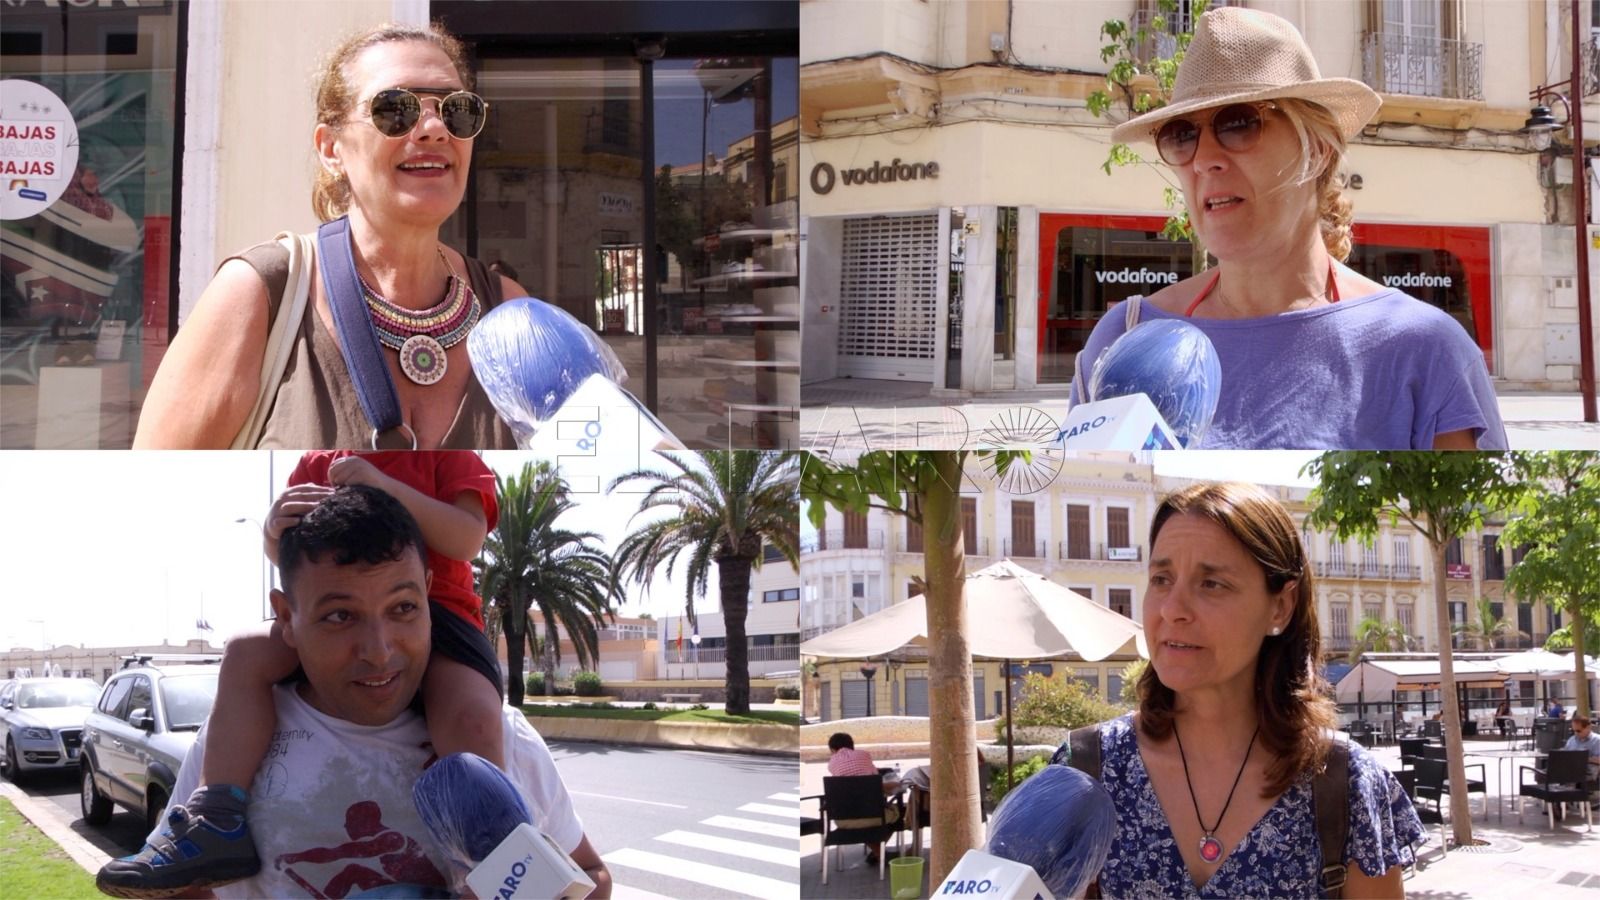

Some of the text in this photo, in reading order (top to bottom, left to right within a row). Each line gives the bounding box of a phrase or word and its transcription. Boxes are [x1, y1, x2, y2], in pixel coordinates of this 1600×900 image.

[840, 158, 940, 186] vodafone
[1095, 267, 1178, 284] vodafone
[1382, 272, 1452, 287] vodafone
[942, 879, 992, 895] FARO
